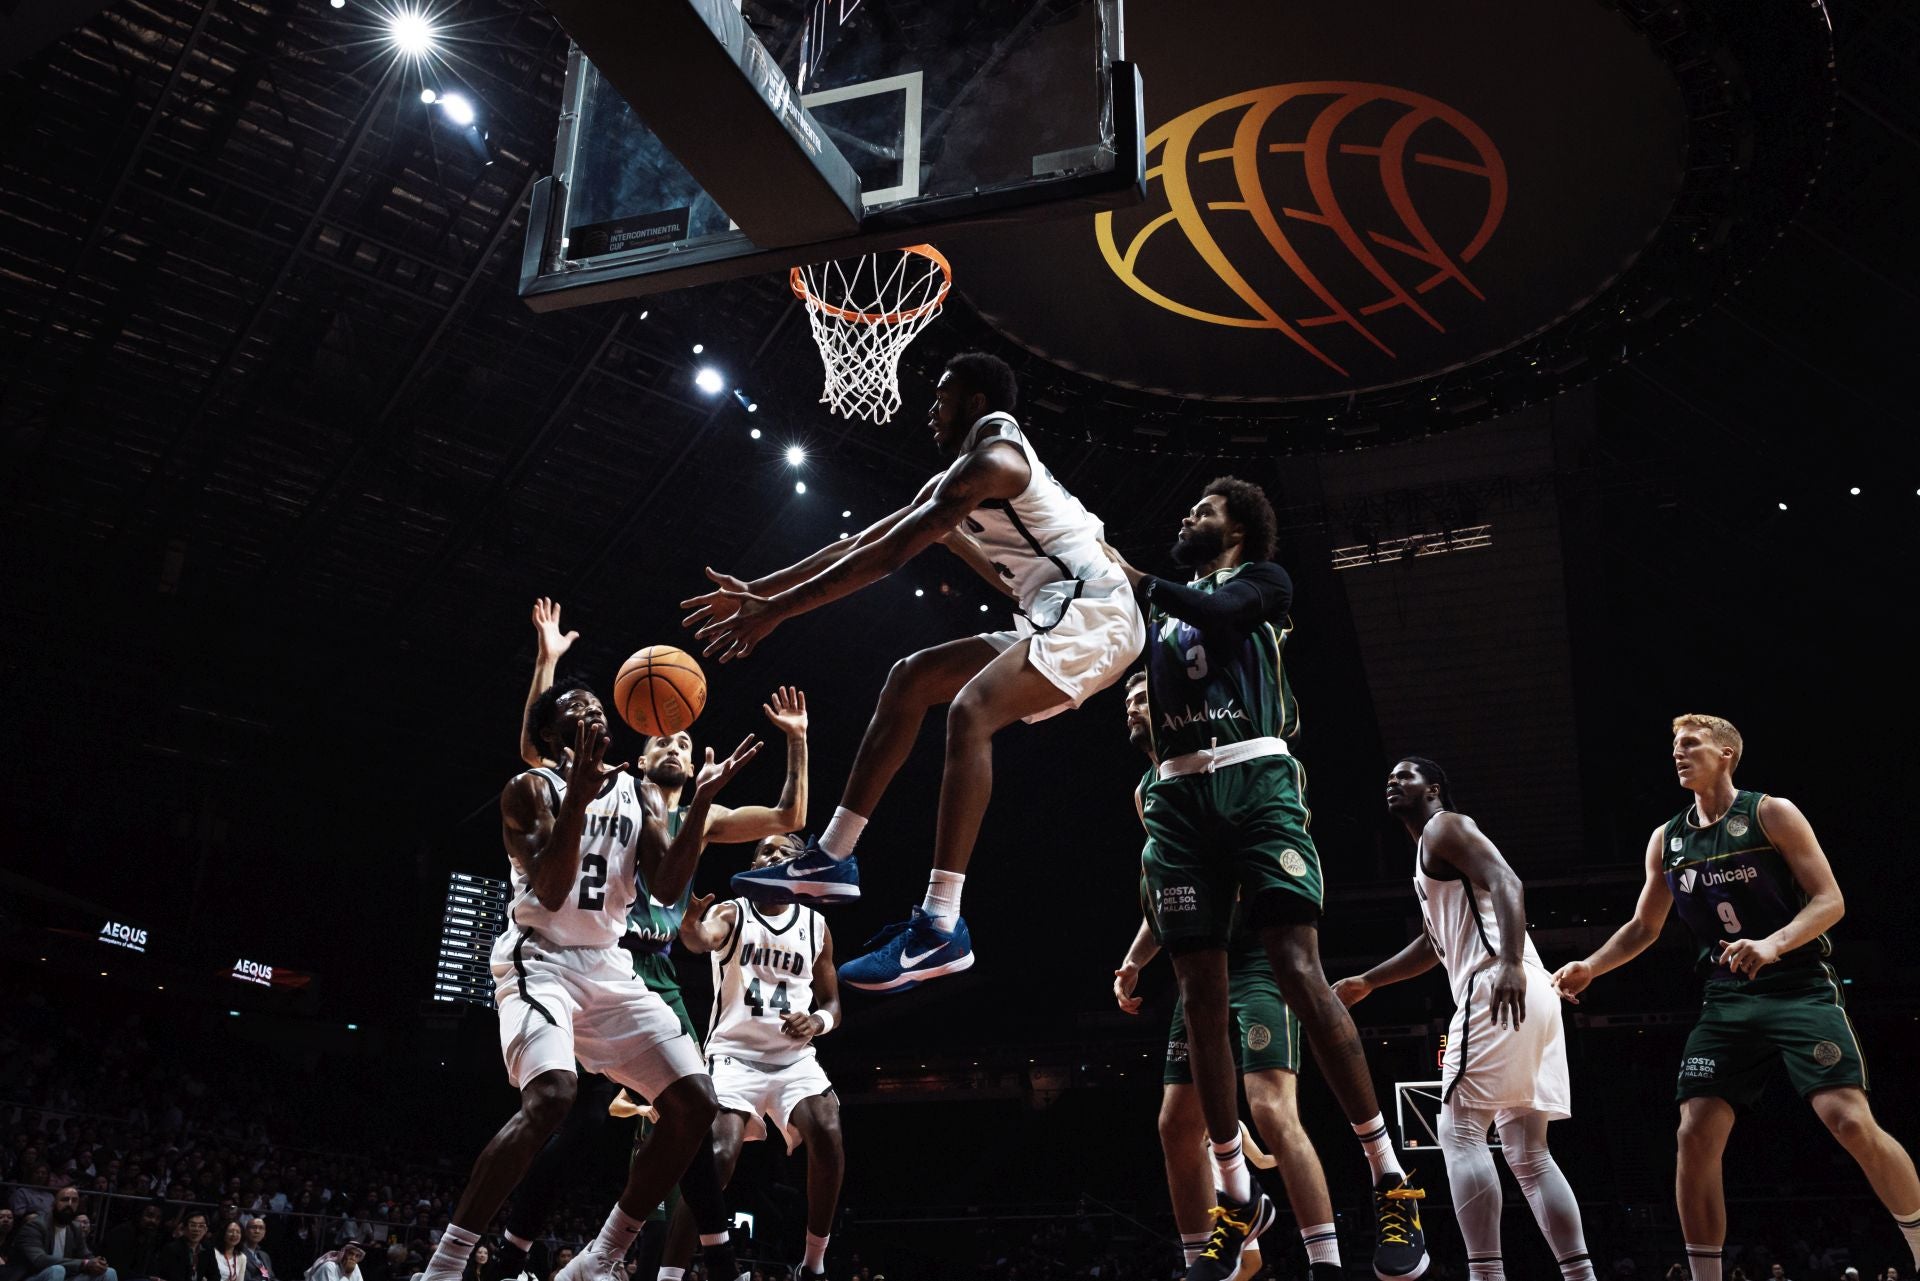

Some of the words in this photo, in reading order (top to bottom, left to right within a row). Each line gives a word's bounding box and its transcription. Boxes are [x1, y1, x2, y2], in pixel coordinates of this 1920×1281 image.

[610, 223, 680, 242] INTERCONTINENTAL
[609, 241, 625, 251] CUP
[1185, 644, 1208, 680] 3
[1160, 698, 1250, 731] Andalucía
[578, 853, 607, 911] 2
[1701, 865, 1758, 887] Unicaja
[1163, 886, 1196, 896] COSTA
[1164, 897, 1178, 905] DEL
[1179, 895, 1197, 904] SOL
[1716, 901, 1742, 934] 9
[100, 921, 148, 945] AEQUS
[232, 958, 273, 979] AEQUS
[739, 943, 804, 976] UNITED
[743, 977, 791, 1017] 44
[1687, 1057, 1716, 1067] COSTA
[1699, 1065, 1715, 1073] SOL
